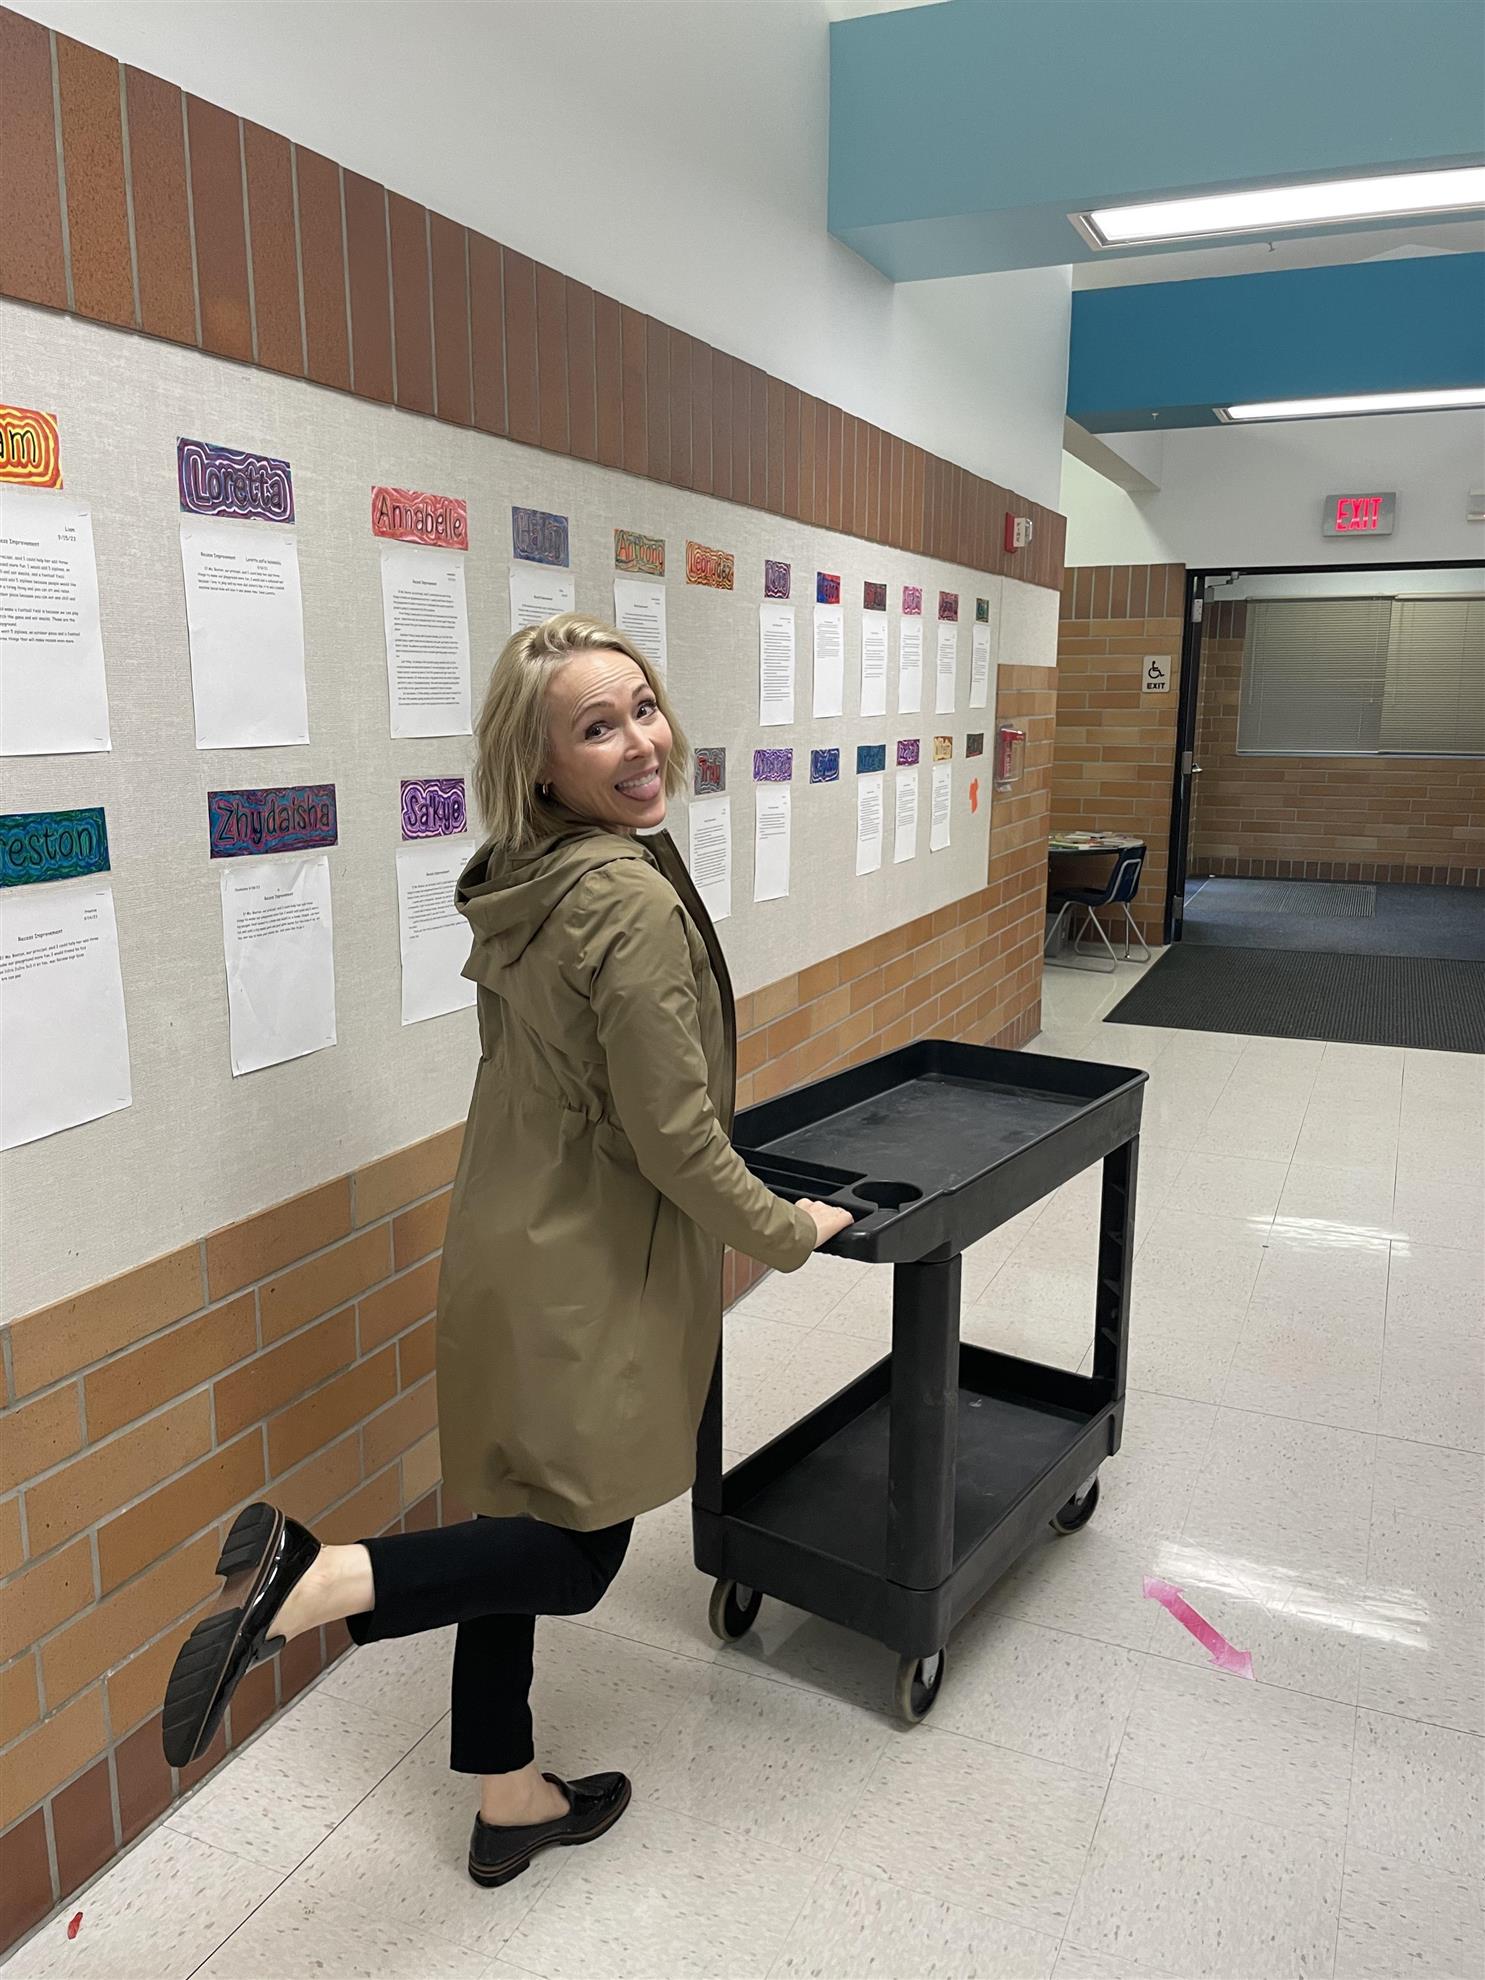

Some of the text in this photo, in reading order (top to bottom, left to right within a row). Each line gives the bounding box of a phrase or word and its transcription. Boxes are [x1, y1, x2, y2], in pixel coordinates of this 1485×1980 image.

[0, 429, 36, 464] m
[190, 456, 284, 513] Loretta
[377, 495, 463, 539] Annabelle
[1335, 497, 1383, 531] EXIT
[9, 538, 39, 547] Improvement
[217, 795, 330, 845] Zhydaisha
[0, 826, 92, 867] eston
[34, 929, 63, 939] Improvement
